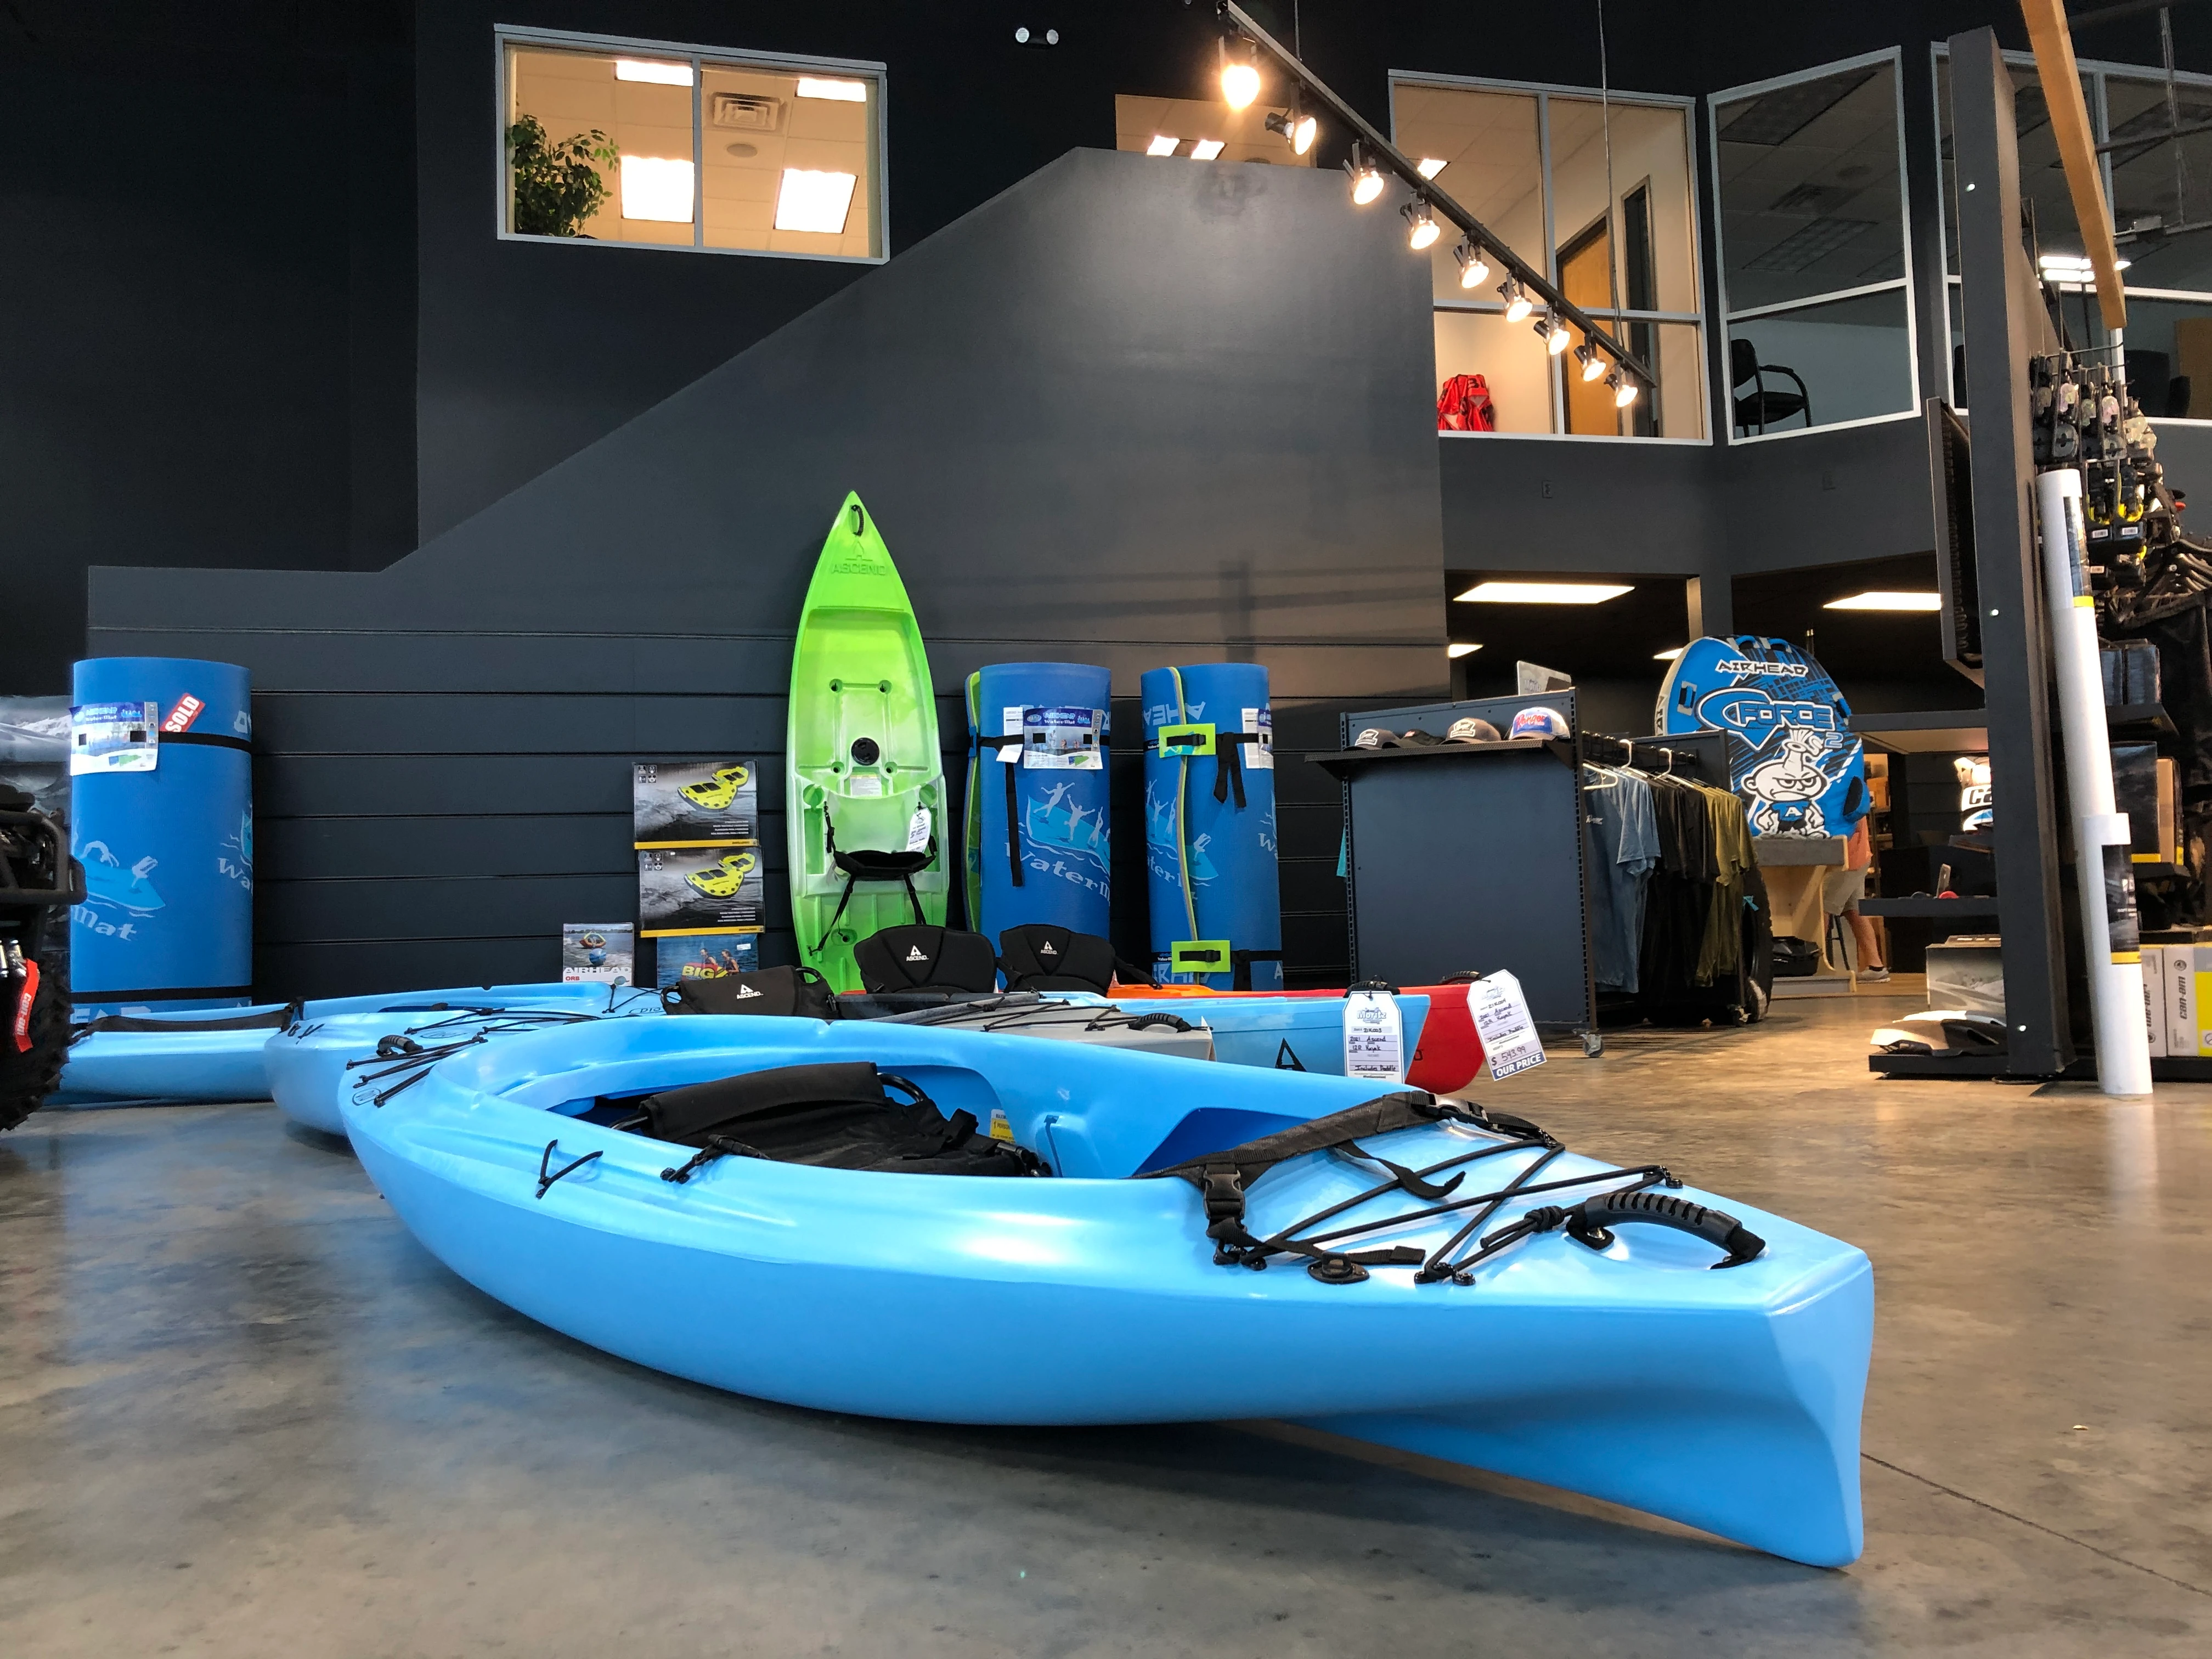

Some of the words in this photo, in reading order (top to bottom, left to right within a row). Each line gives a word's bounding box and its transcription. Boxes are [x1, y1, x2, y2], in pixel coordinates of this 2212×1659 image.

[831, 563, 886, 576] ASCEND
[1716, 660, 1808, 676] AIRHEAD
[166, 696, 199, 732] SOLD
[682, 966, 714, 979] BIG
[737, 991, 761, 999] ASCEND
[1357, 1010, 1386, 1019] Moritz
[1501, 1046, 1526, 1062] 543.99
[1496, 1064, 1515, 1077] OUR
[1516, 1053, 1542, 1070] PRICE
